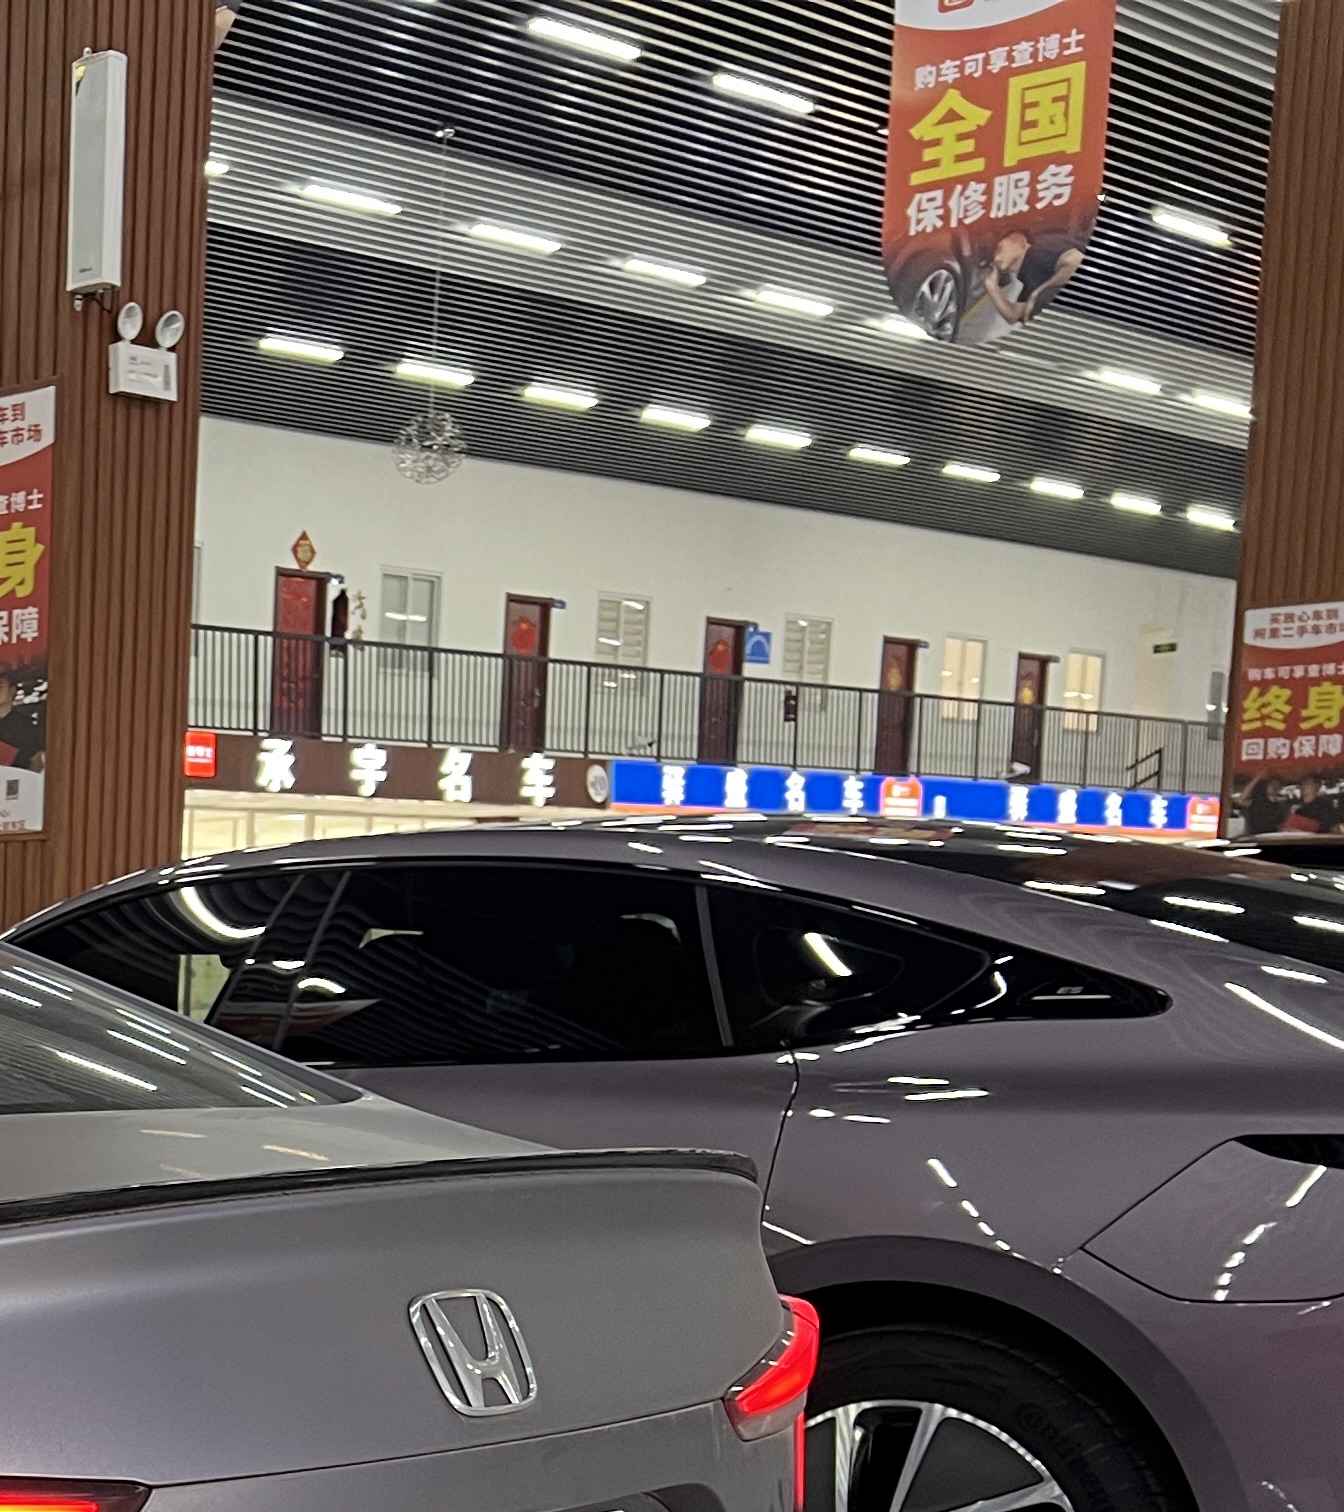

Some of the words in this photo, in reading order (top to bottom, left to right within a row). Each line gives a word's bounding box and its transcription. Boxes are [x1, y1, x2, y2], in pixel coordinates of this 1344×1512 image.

[914, 28, 1086, 91] 购车可享查博士
[908, 61, 1087, 186] 全国
[905, 164, 1076, 236] 保修服务
[1241, 680, 1344, 731] 终身
[1241, 733, 1344, 761] 回购保障
